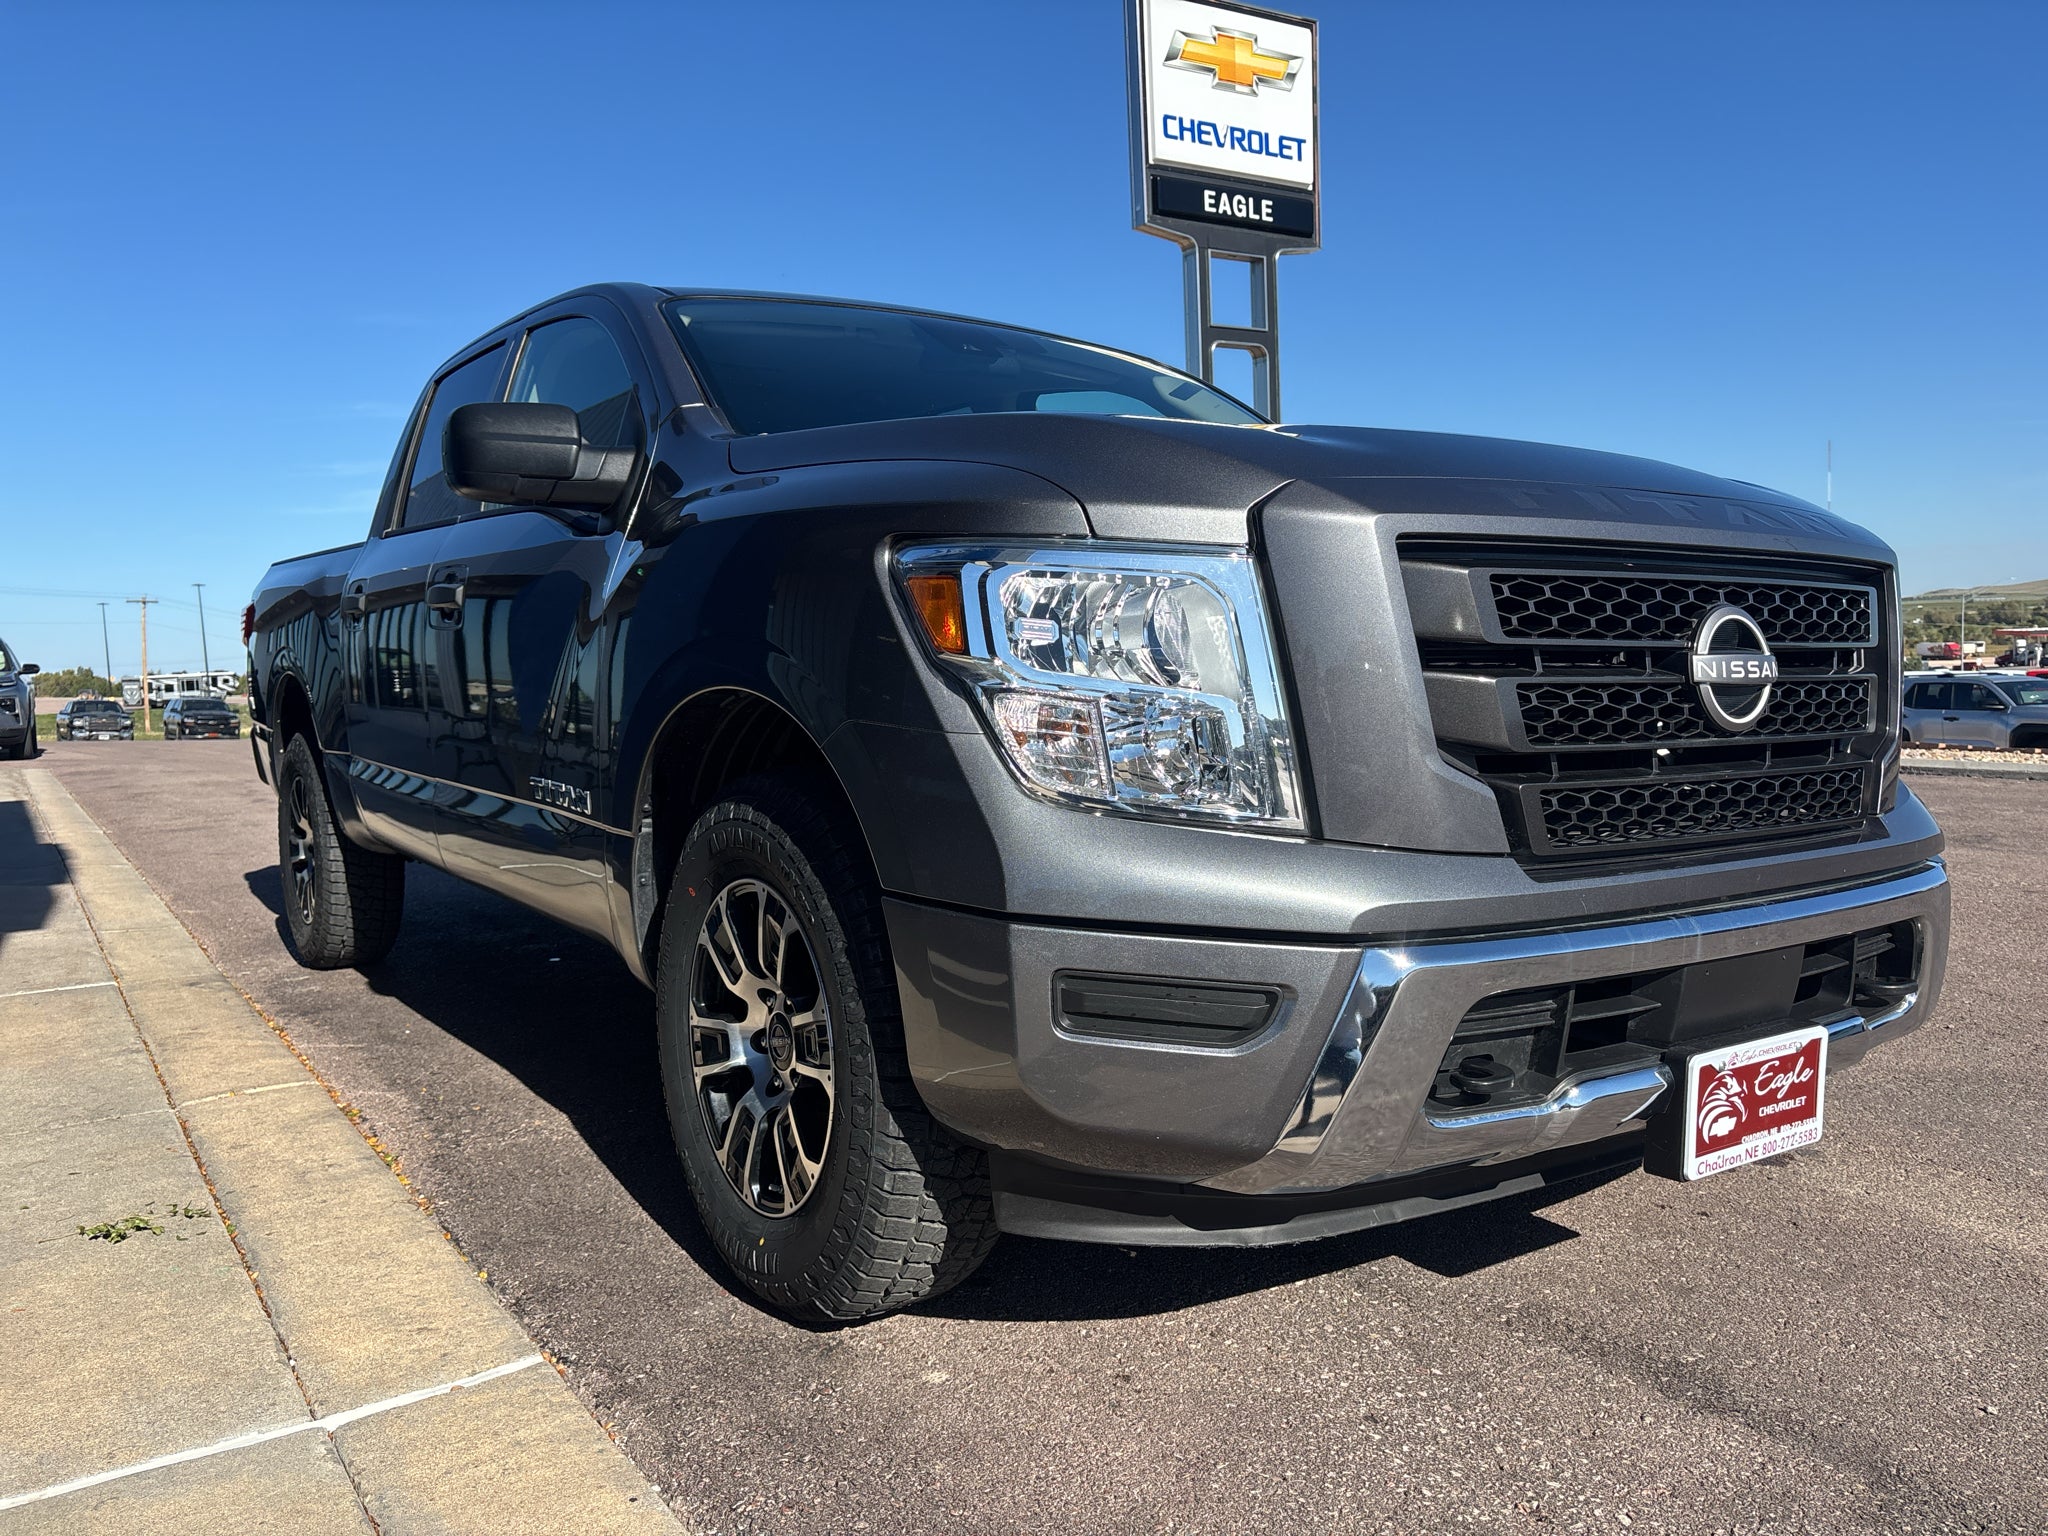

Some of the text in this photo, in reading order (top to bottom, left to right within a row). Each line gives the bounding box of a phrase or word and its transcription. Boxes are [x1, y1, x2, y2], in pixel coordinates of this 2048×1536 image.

[1163, 114, 1306, 162] CHEVROLET
[1203, 189, 1274, 222] EAGLE
[1697, 660, 1779, 678] NISSAN
[529, 776, 592, 815] TITAN
[1754, 1056, 1814, 1099] Eagle
[1758, 1095, 1807, 1117] CHEVROLET
[1745, 1144, 1759, 1161] NE
[1762, 1127, 1818, 1155] 800-272-5583
